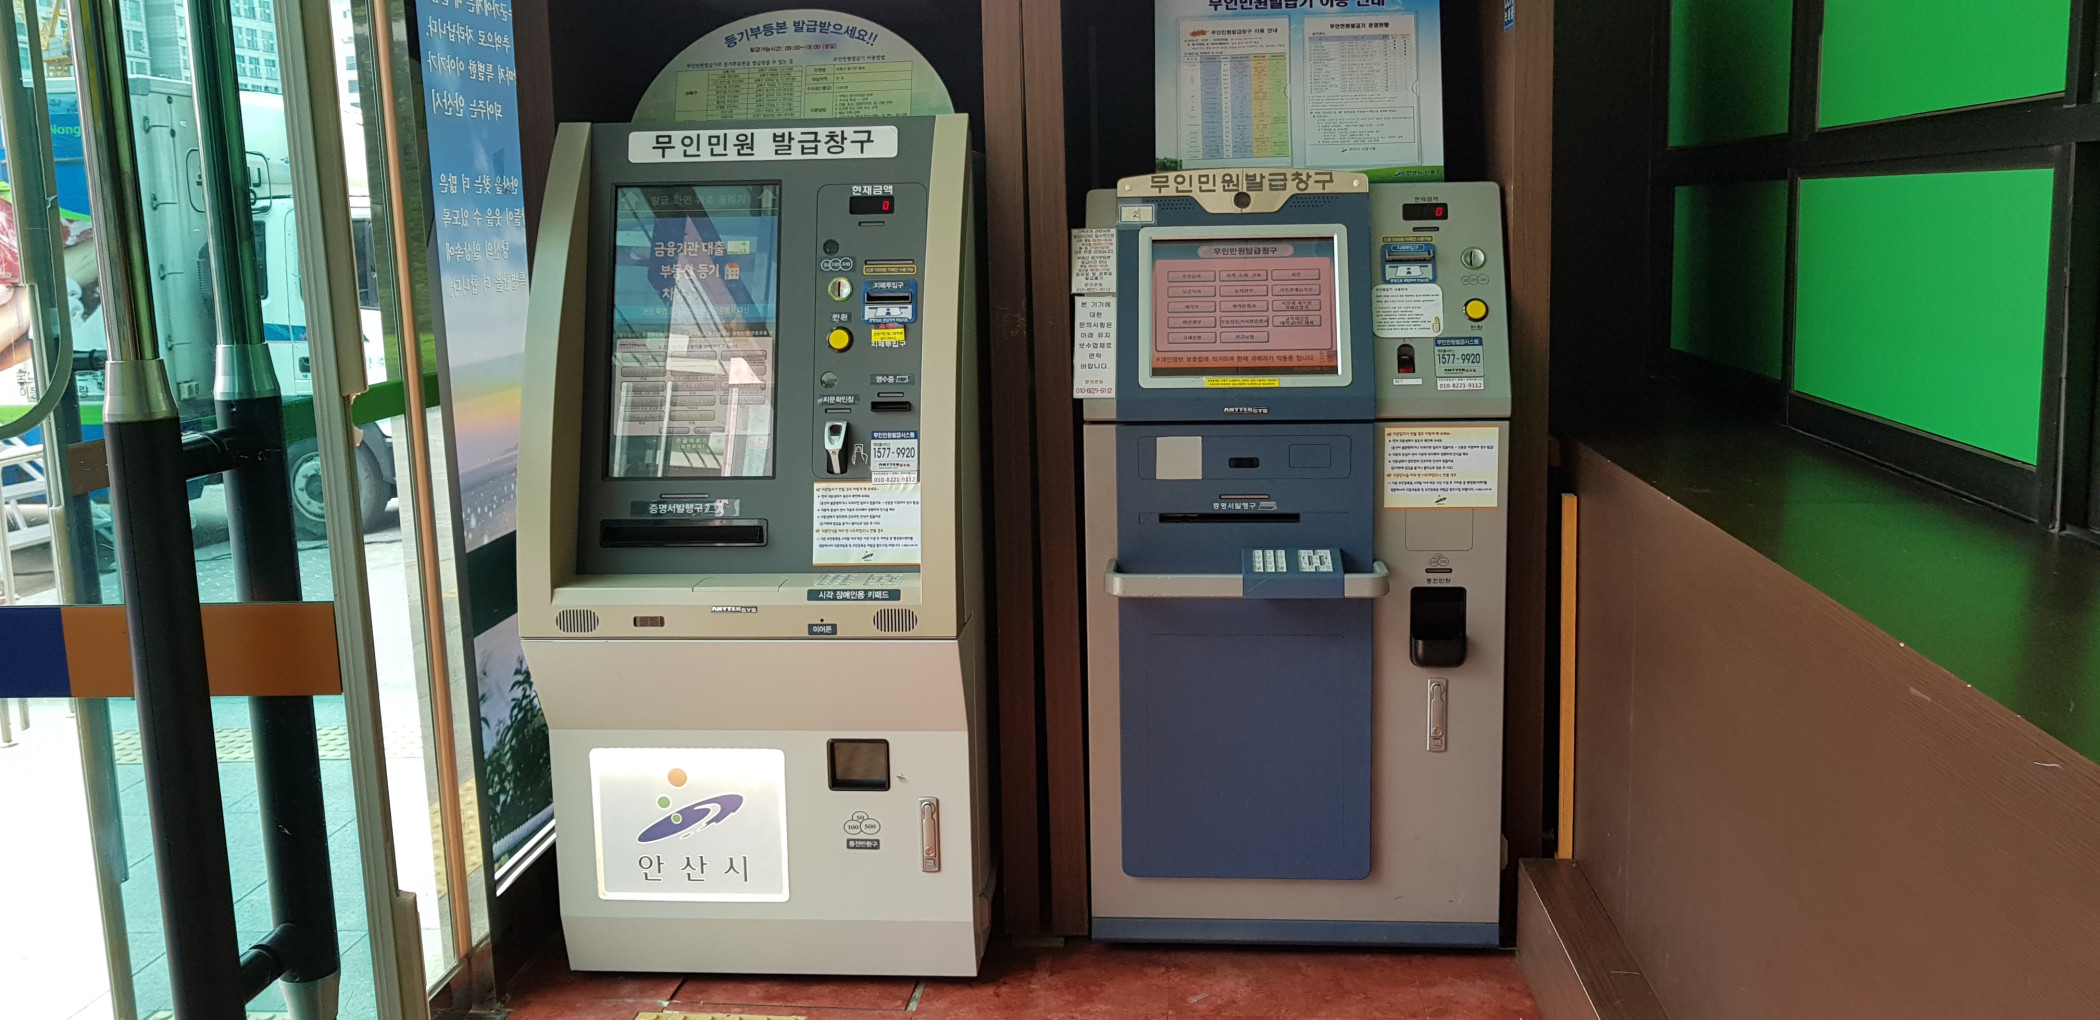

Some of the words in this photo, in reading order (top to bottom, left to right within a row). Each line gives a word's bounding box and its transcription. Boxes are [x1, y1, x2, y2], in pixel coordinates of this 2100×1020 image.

[724, 22, 788, 49] 등기부등본
[793, 20, 878, 47] 발급받으세요!!
[651, 132, 755, 159] 무인민원
[772, 129, 875, 156] 발급창구
[1150, 171, 1335, 194] 무인민원발급창구
[852, 185, 893, 196] 현재금액
[882, 200, 890, 211] 0
[1434, 206, 1444, 218] 0
[654, 241, 700, 257] 금융기관
[702, 241, 725, 256] 대출
[698, 263, 721, 280] 등기
[1089, 311, 1102, 319] 대한
[1079, 321, 1113, 329] 문의사항은
[1437, 353, 1481, 365] 1577-9920
[1080, 362, 1110, 370] 바랍니다.
[873, 447, 916, 459] 1577-9920
[818, 590, 834, 601] 시각
[836, 589, 864, 601] 장애인용
[867, 589, 890, 600] 키패드
[813, 625, 833, 634] 이어폰
[864, 822, 877, 830] 500
